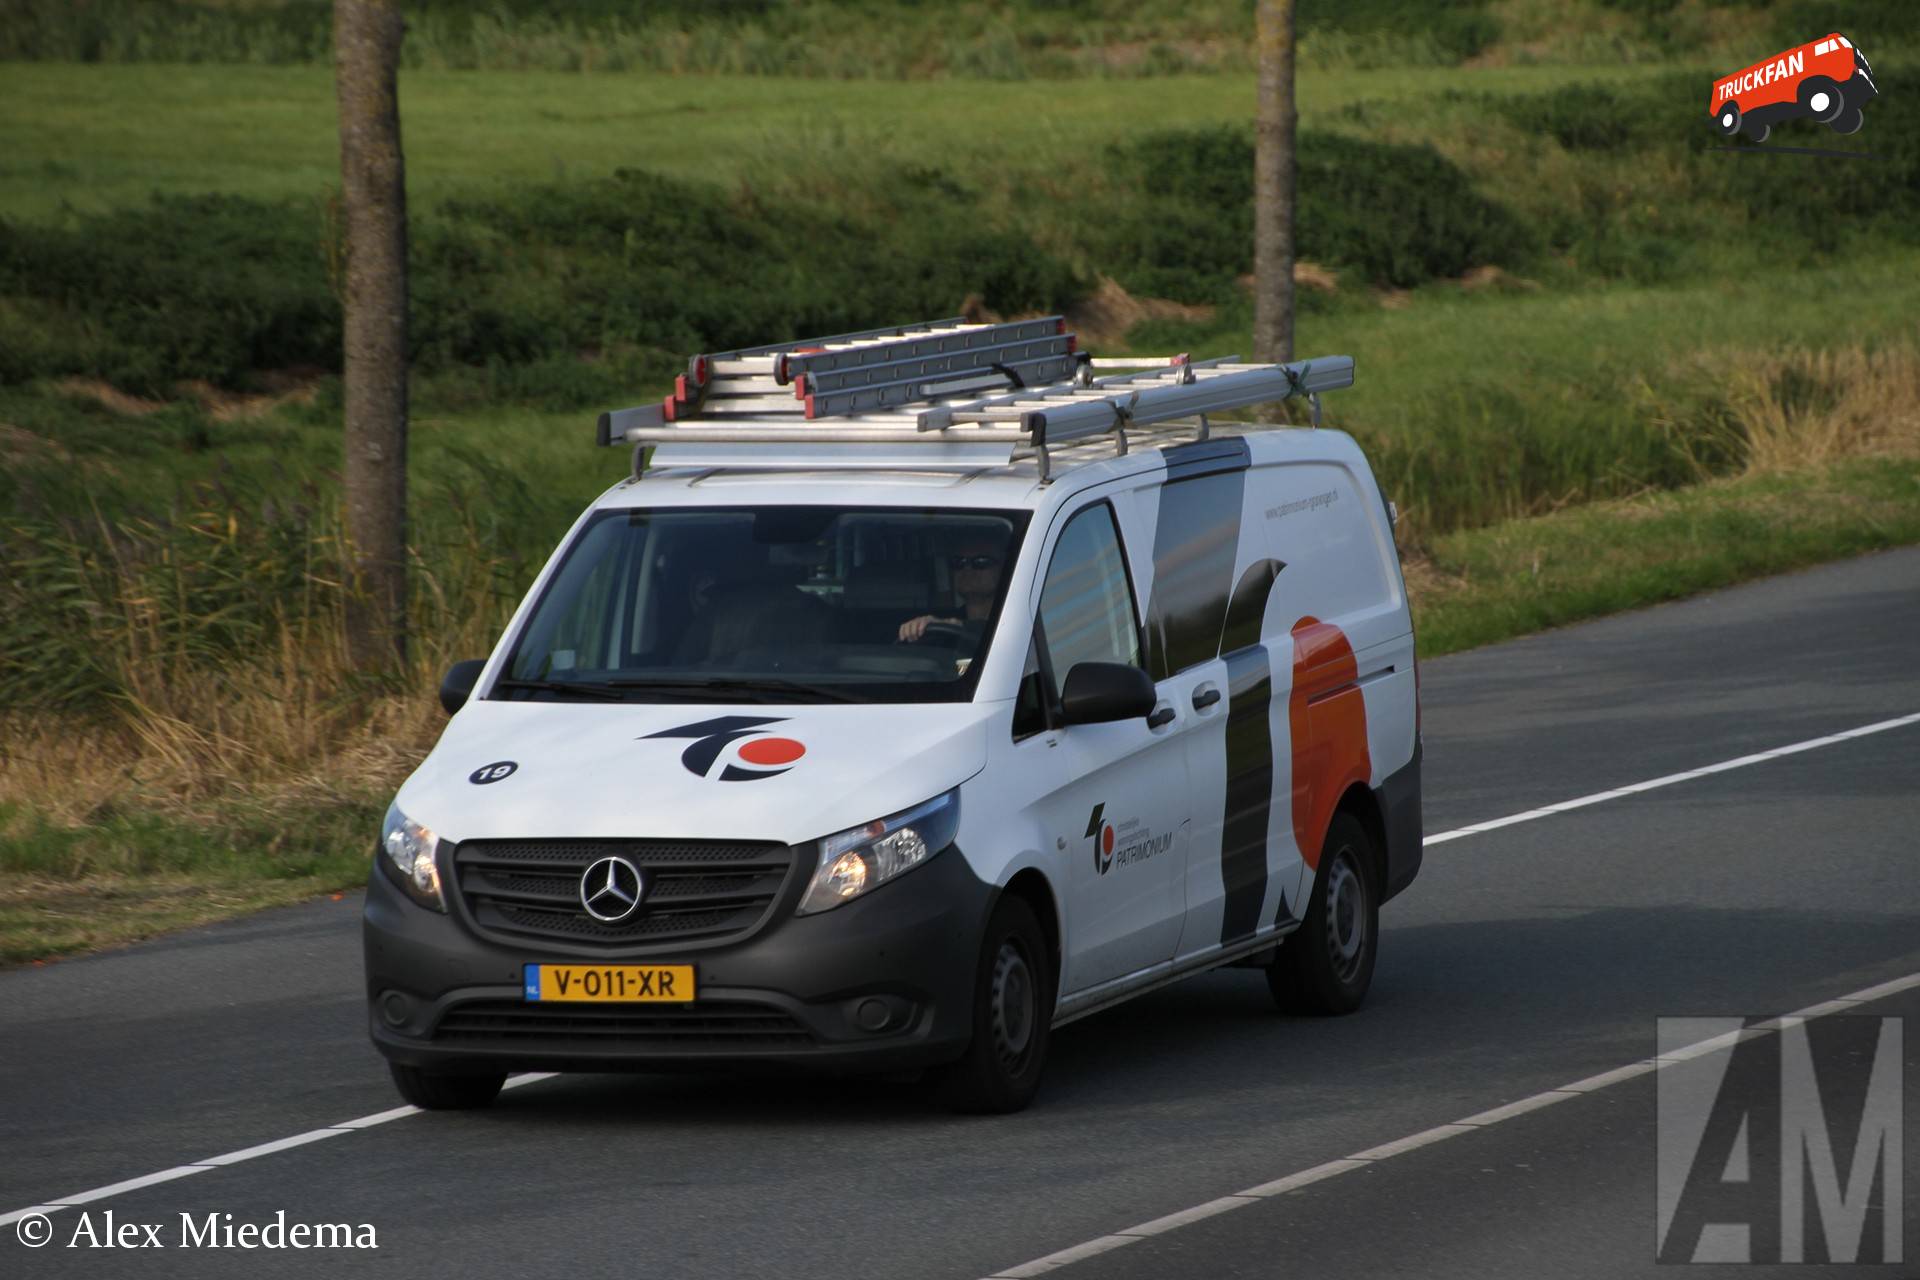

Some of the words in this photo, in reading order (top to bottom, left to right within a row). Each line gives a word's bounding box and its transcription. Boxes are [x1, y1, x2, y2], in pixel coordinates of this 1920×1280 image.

[479, 765, 512, 780] 19
[1116, 832, 1172, 868] PATRIMONIUM
[554, 970, 675, 996] V-011-XR
